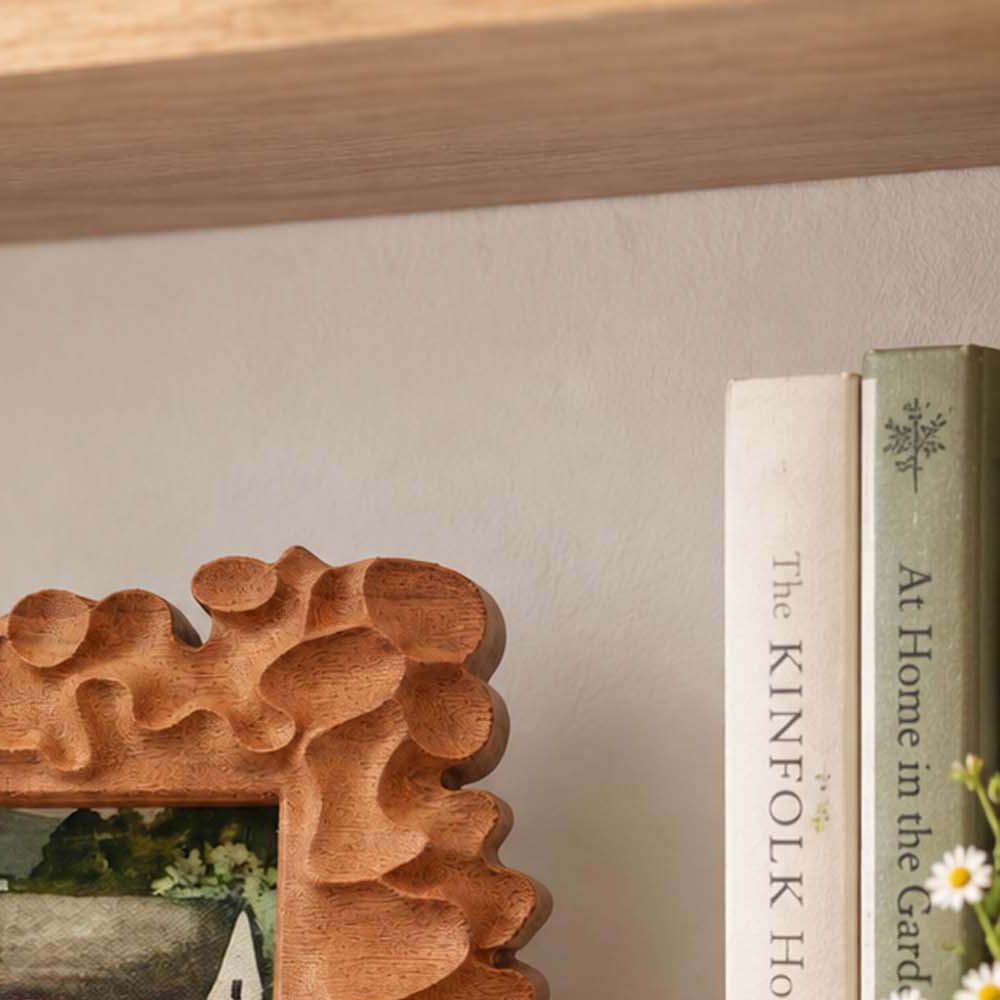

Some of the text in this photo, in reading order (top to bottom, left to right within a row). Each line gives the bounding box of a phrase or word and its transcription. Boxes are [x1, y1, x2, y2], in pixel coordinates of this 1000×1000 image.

[773, 551, 803, 619] The
[897, 562, 933, 612] At
[897, 625, 933, 748] Home
[769, 640, 804, 909] KINFOLK
[897, 760, 932, 799] in
[897, 812, 934, 872] the
